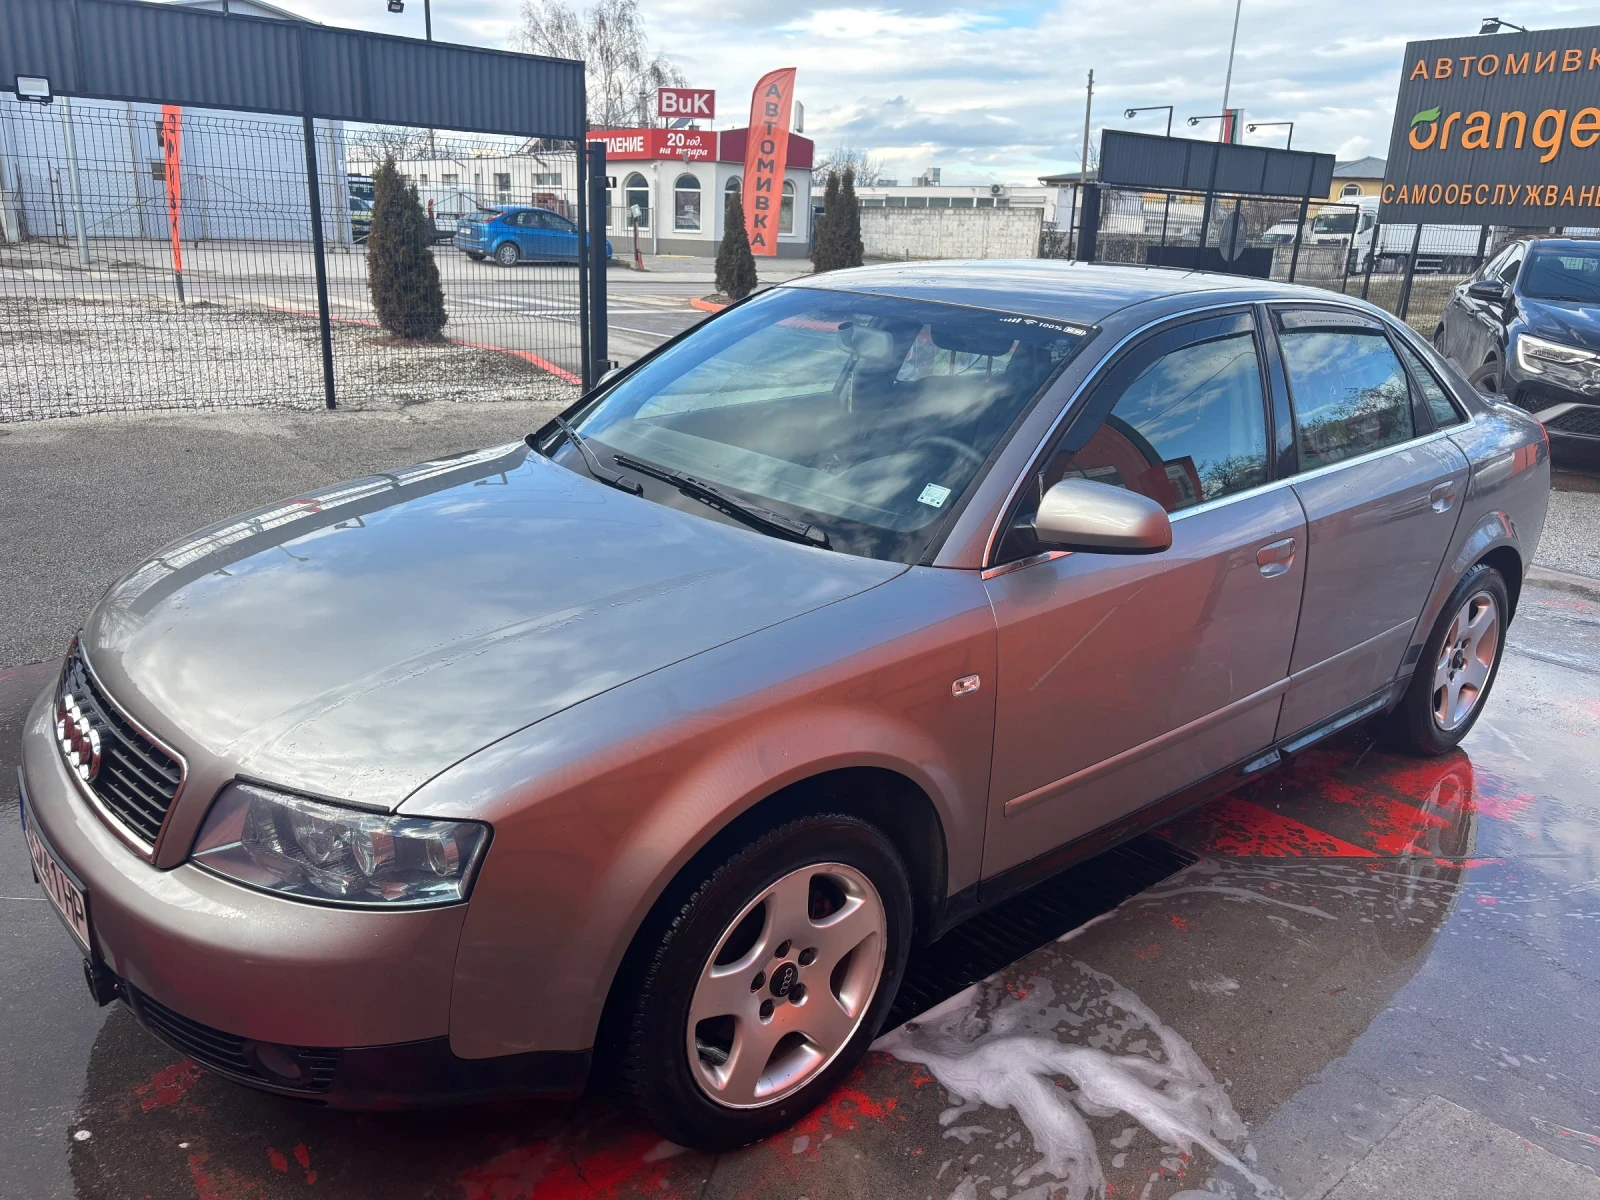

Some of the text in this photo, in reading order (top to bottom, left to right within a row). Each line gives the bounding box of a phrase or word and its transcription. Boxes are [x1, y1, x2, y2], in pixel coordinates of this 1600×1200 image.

[586, 136, 644, 153] ПЛЕНИЕ
[667, 132, 685, 147] 20
[659, 146, 708, 159] на пзара
[750, 83, 782, 247] АВТОМИВКА
[1038, 322, 1063, 331] 100%
